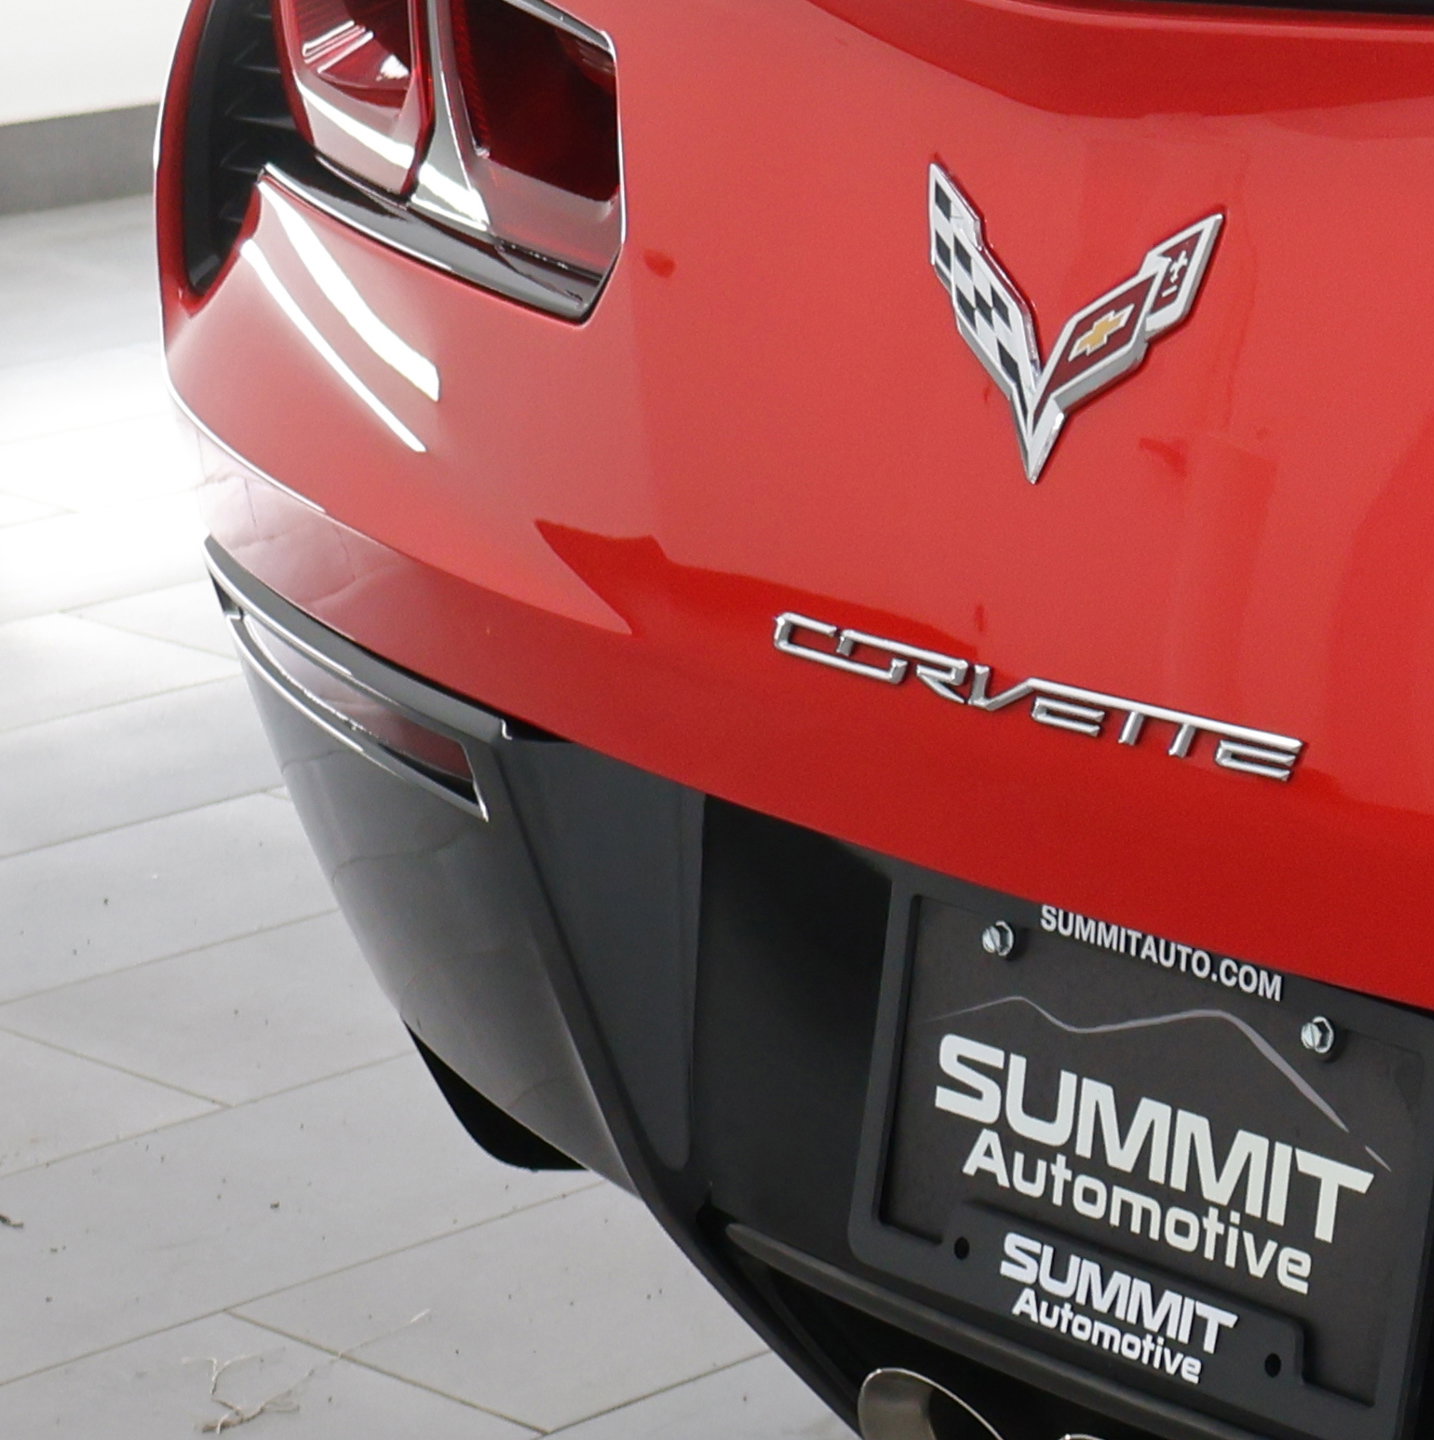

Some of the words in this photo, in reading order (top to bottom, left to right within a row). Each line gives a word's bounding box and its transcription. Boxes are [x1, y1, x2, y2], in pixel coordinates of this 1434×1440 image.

[773, 611, 1306, 781] CORVETTE
[1040, 904, 1283, 1002] SUMMITAUTO.COM
[935, 1033, 1374, 1243] SUMMIT
[962, 1129, 1311, 1294] Automotive
[1000, 1231, 1238, 1353] SUMMIT
[1012, 1288, 1201, 1384] Automotive
